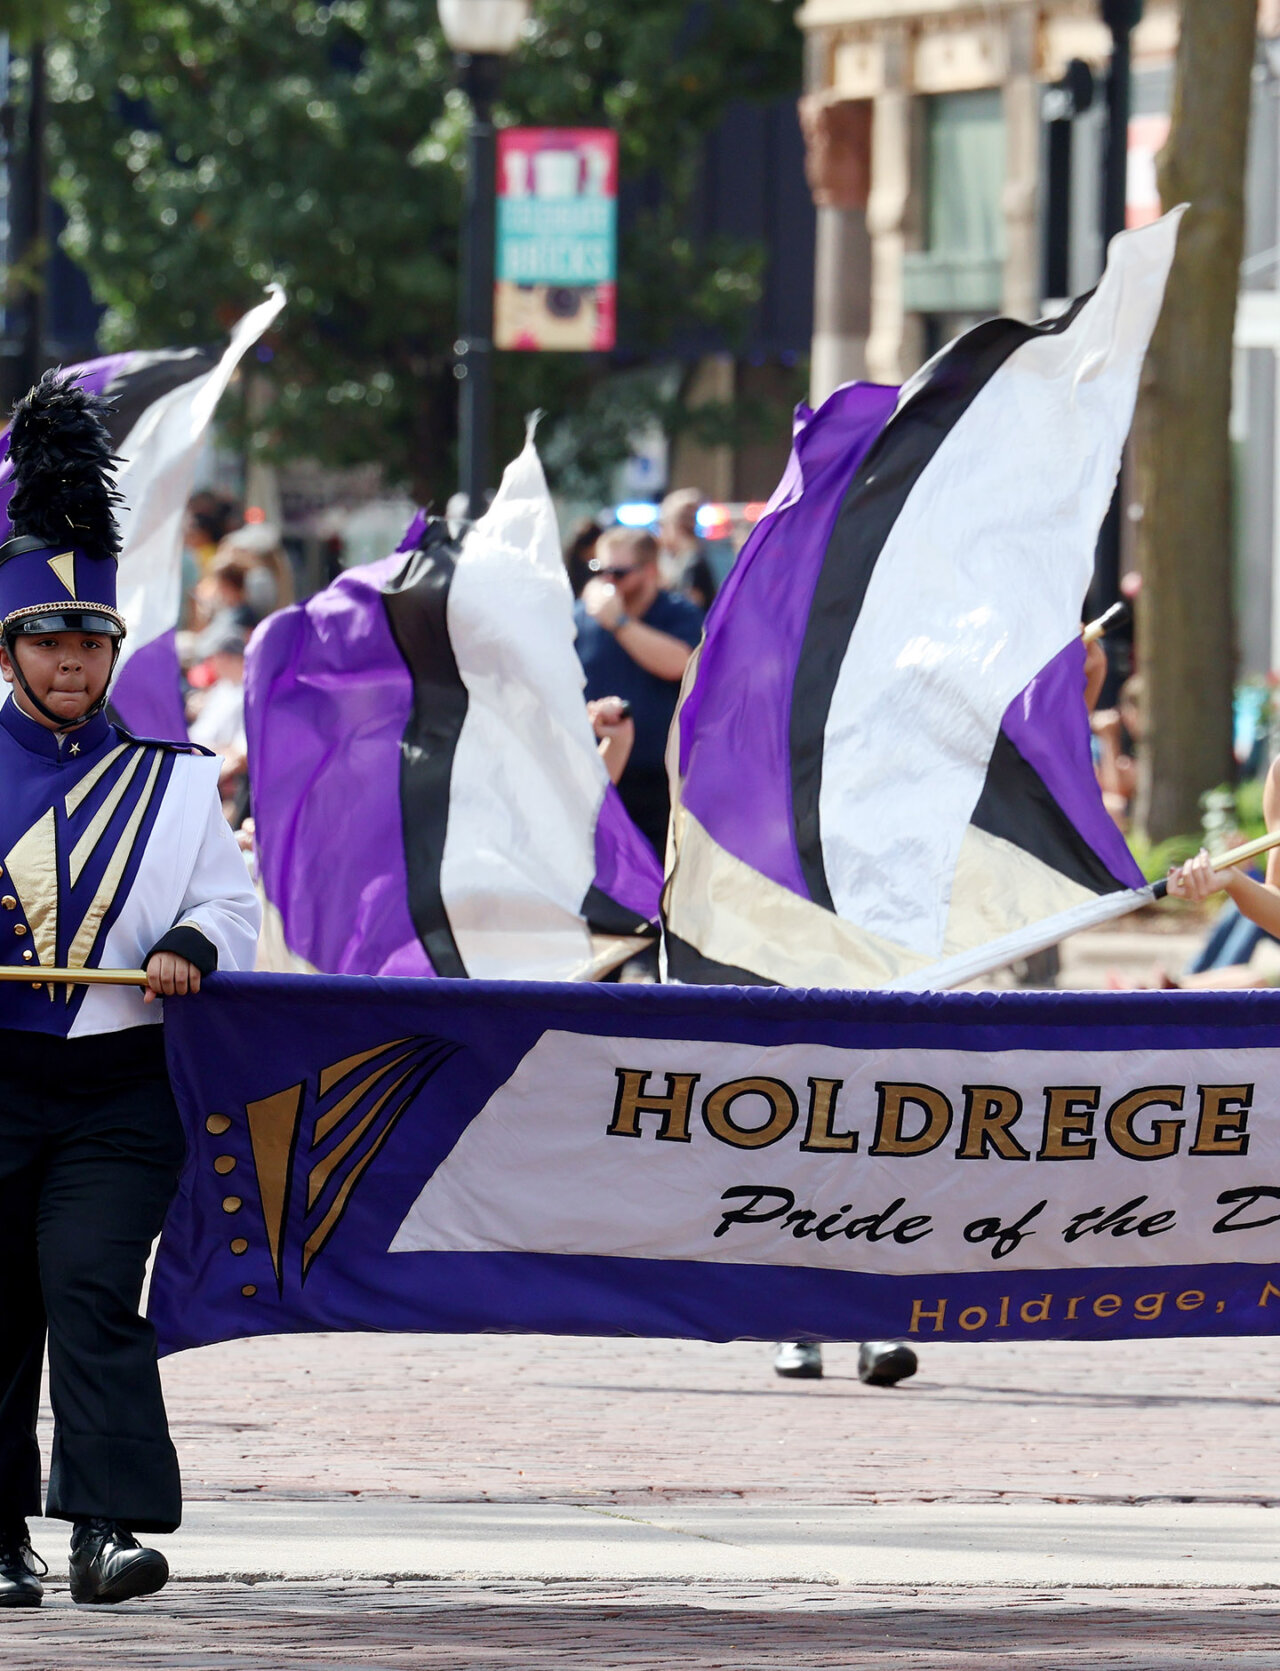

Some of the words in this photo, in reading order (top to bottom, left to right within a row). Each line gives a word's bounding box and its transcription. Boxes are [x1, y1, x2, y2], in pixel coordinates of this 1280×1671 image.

[606, 1066, 1255, 1162] HOLDREGE
[713, 1184, 934, 1244] Pride
[963, 1199, 1048, 1260] of
[1062, 1194, 1177, 1244] the
[907, 1288, 1226, 1333] Holdrege,
